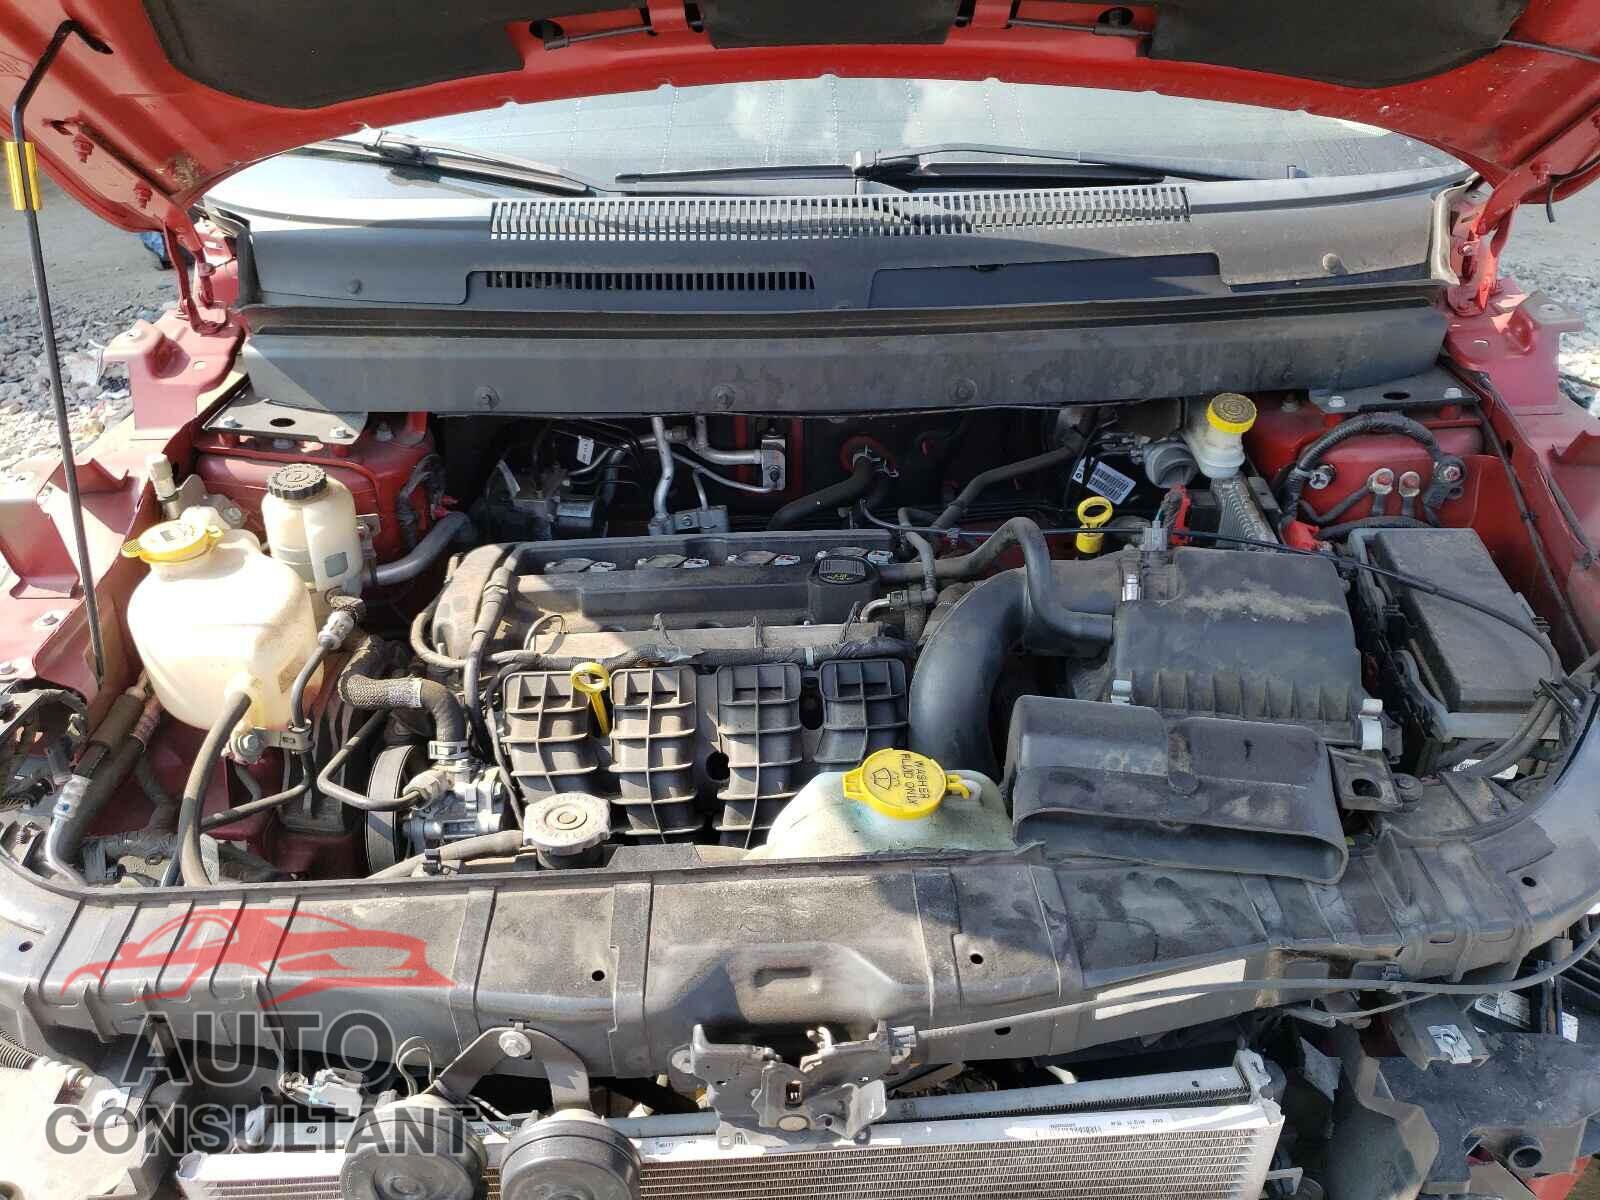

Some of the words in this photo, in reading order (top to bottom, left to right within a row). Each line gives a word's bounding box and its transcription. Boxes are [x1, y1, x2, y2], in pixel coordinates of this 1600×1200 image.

[900, 753, 913, 779] FLUID
[914, 760, 930, 799] WASHER
[905, 781, 919, 805] ONLY
